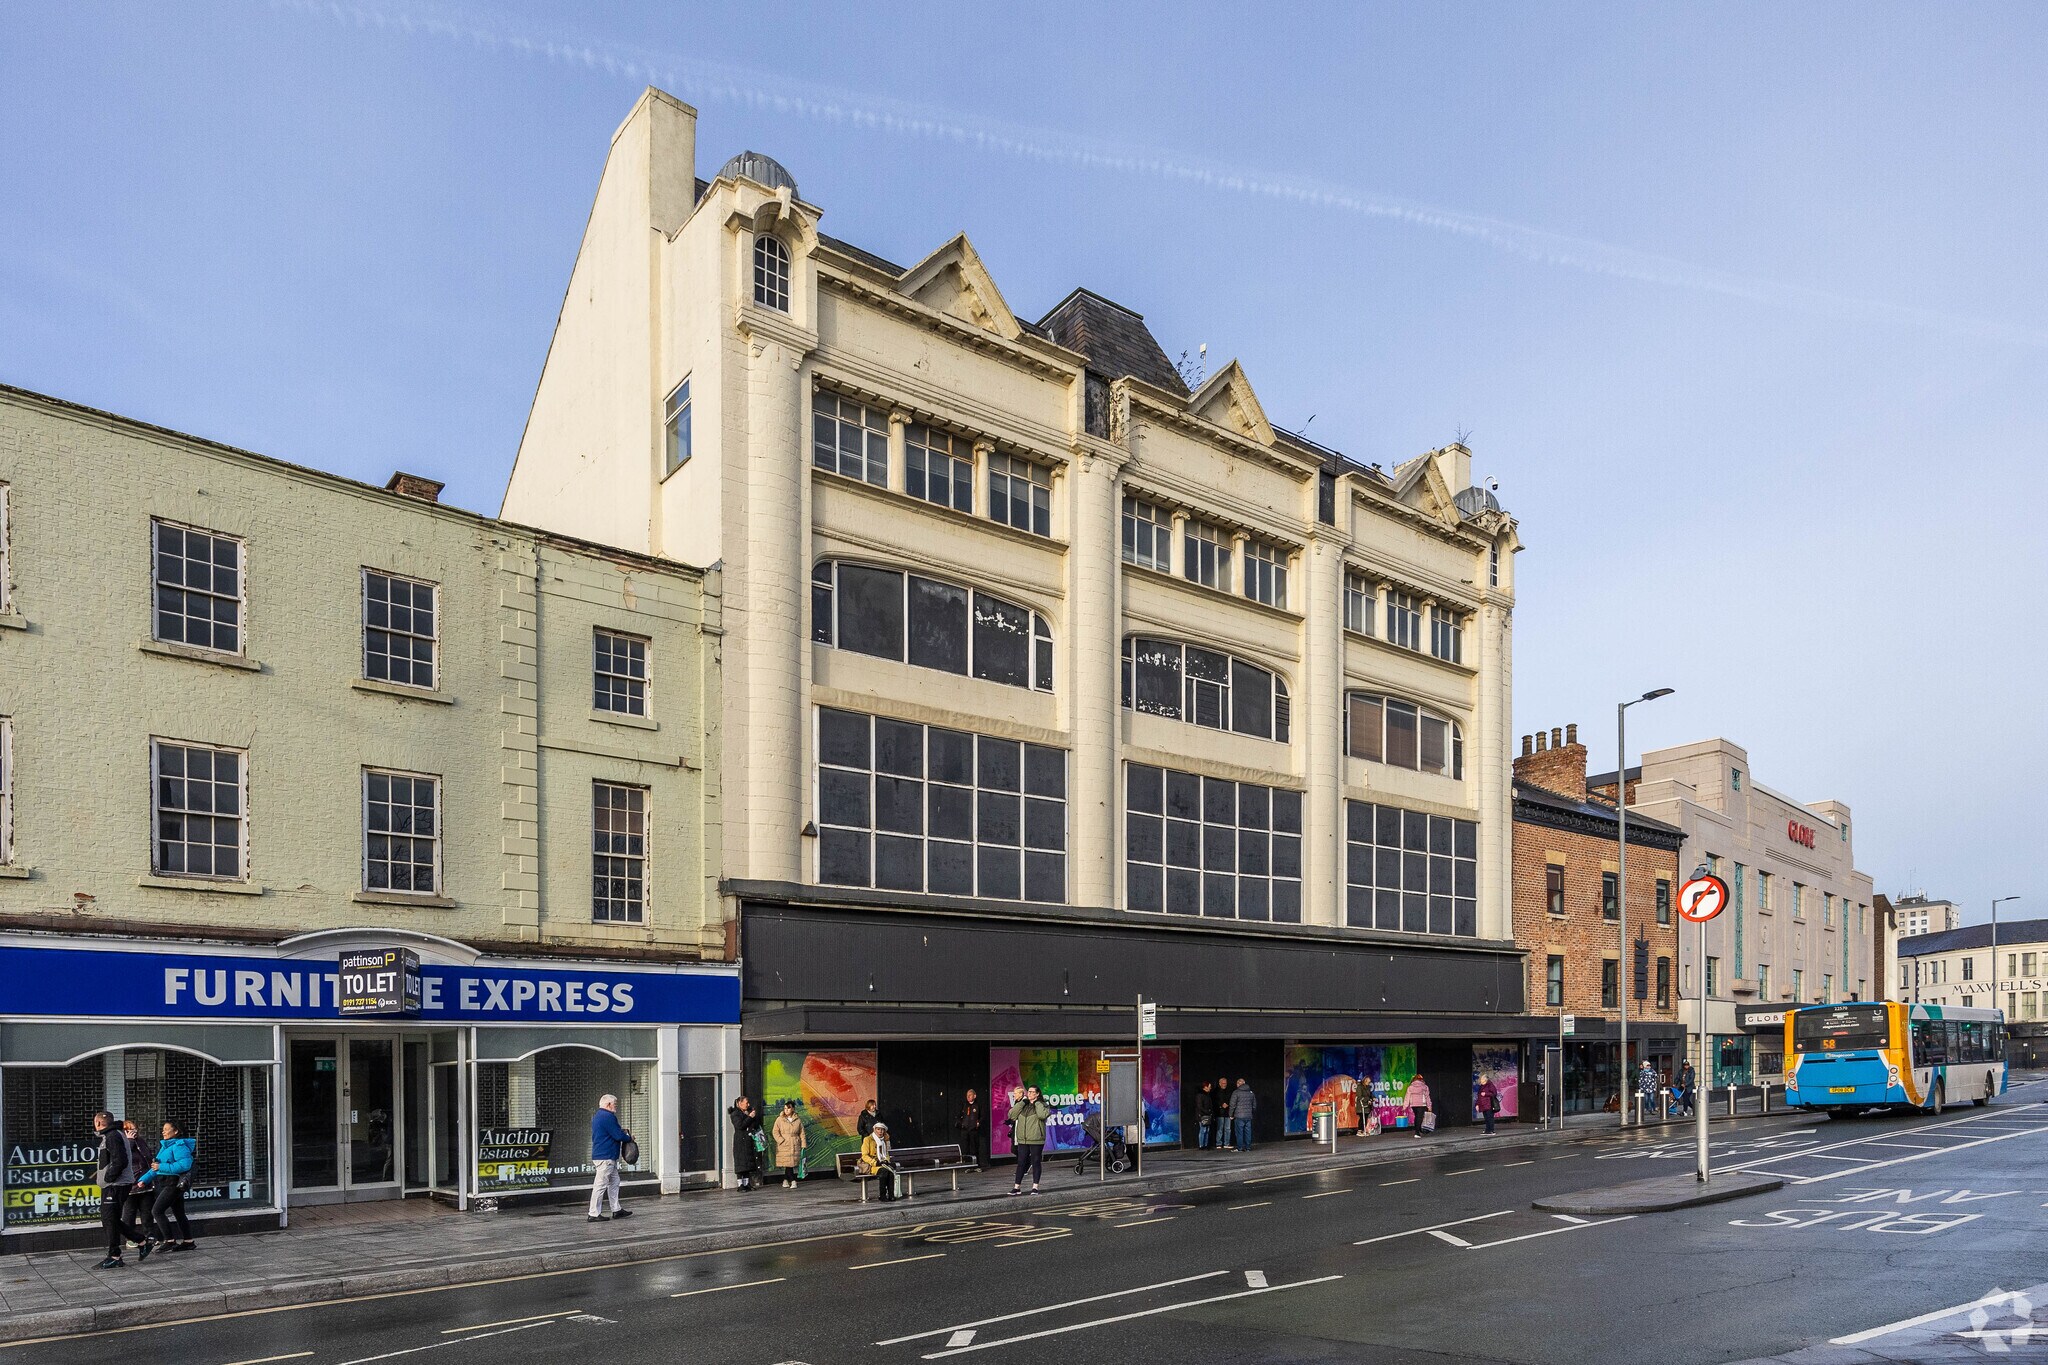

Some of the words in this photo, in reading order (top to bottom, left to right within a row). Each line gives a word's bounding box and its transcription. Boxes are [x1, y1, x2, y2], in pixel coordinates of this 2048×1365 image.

[342, 955, 383, 970] pattinson
[343, 974, 364, 994] TO
[366, 972, 397, 993] LET
[1952, 980, 2042, 995] MAXWELL'S
[165, 968, 444, 1010] FURNITE
[459, 978, 634, 1014] EXPRESS
[1822, 1039, 1836, 1049] 58
[1392, 1078, 1404, 1091] to
[481, 1130, 550, 1145] Auction
[8, 1144, 99, 1166] Auctio
[478, 1148, 529, 1160] Estates
[8, 1168, 85, 1184] Estates
[60, 1187, 101, 1203] SAL
[183, 1187, 222, 1199] ebook
[68, 1195, 101, 1207] Follo
[1728, 1209, 1985, 1235] BUS
[862, 1221, 1073, 1243] STOP
